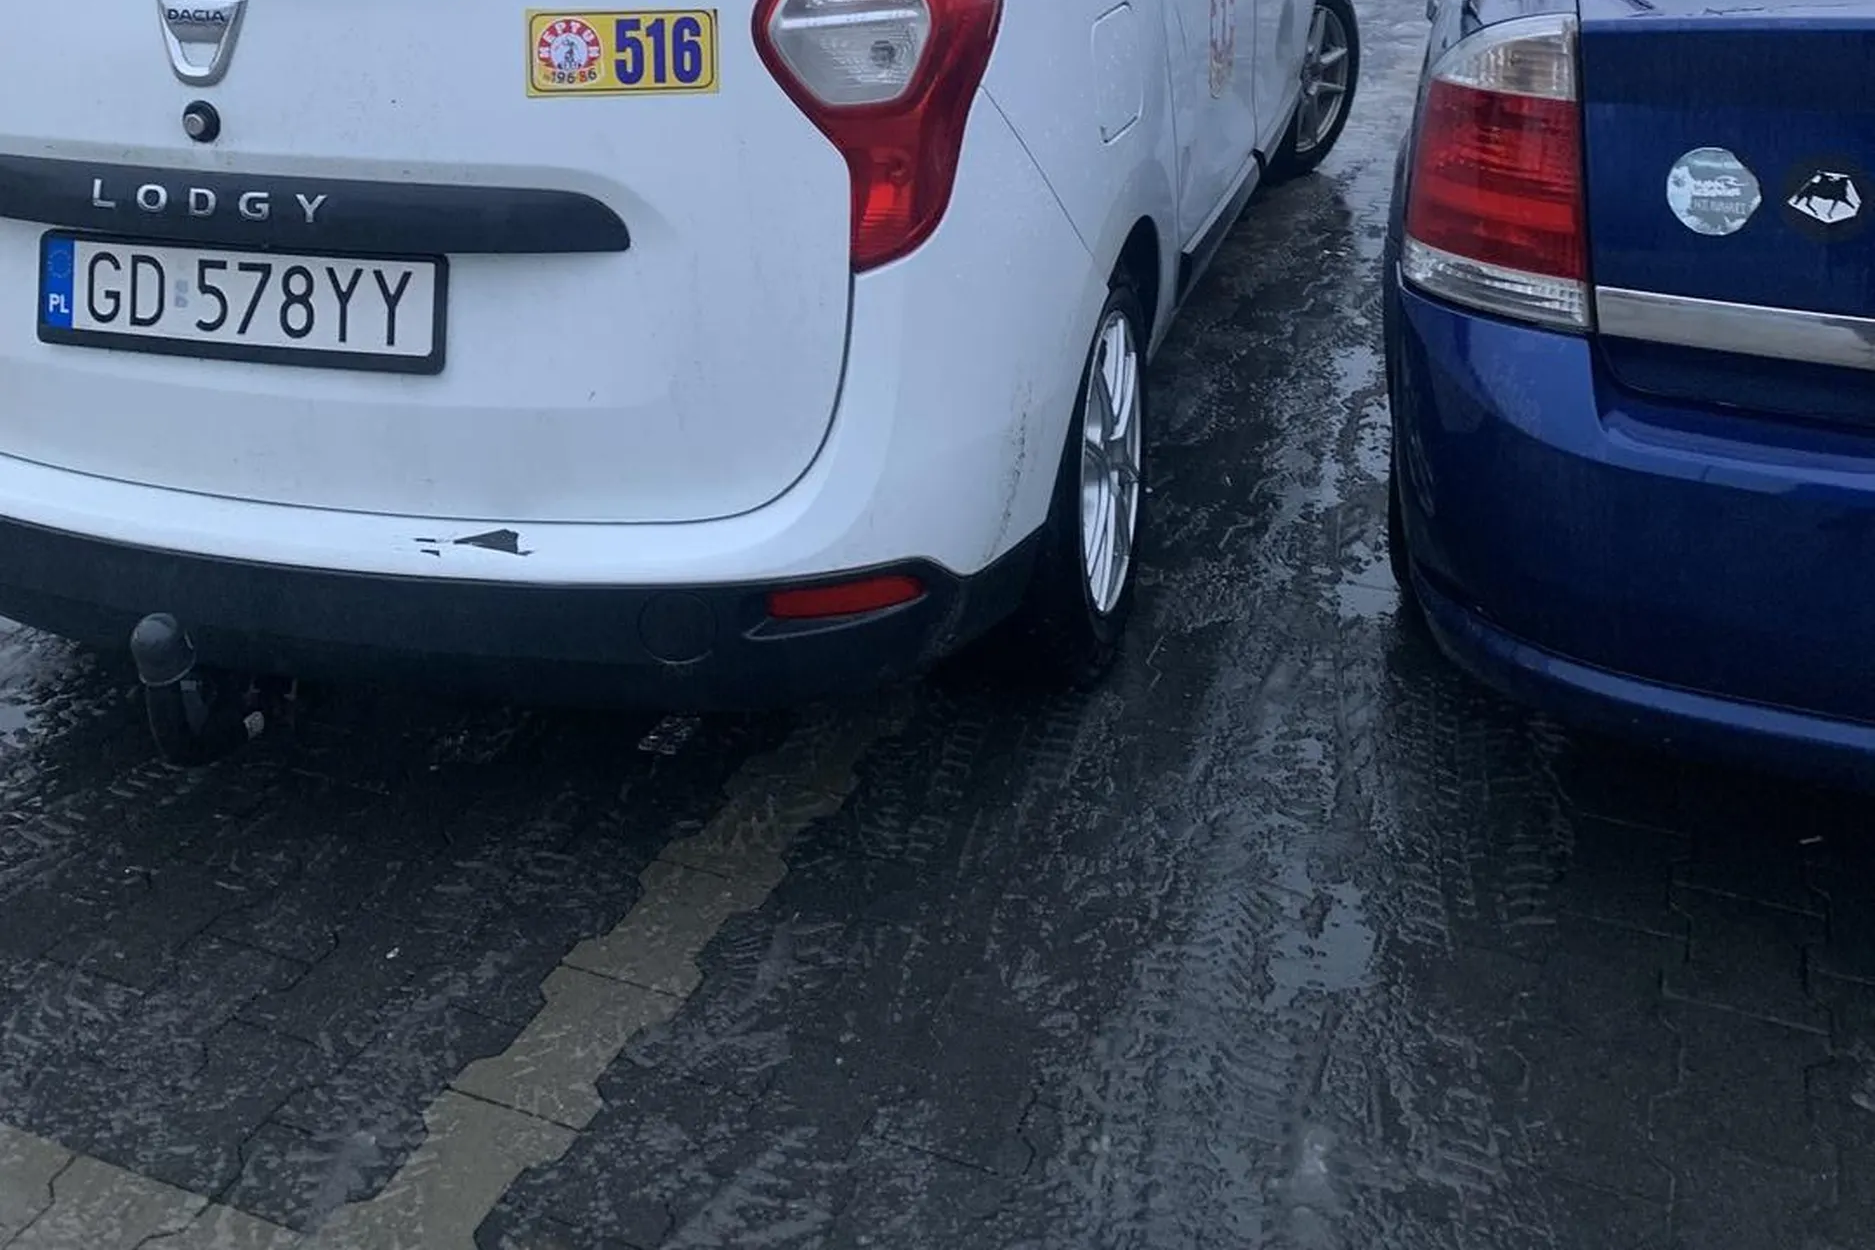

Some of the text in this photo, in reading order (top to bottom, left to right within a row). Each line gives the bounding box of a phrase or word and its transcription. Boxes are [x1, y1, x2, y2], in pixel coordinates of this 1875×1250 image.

[167, 8, 225, 22] DACIA
[538, 20, 600, 59] NEPTUN
[614, 16, 702, 85] 516
[92, 178, 329, 224] LODGY
[48, 292, 70, 315] PL
[87, 251, 413, 347] GD 578YY
